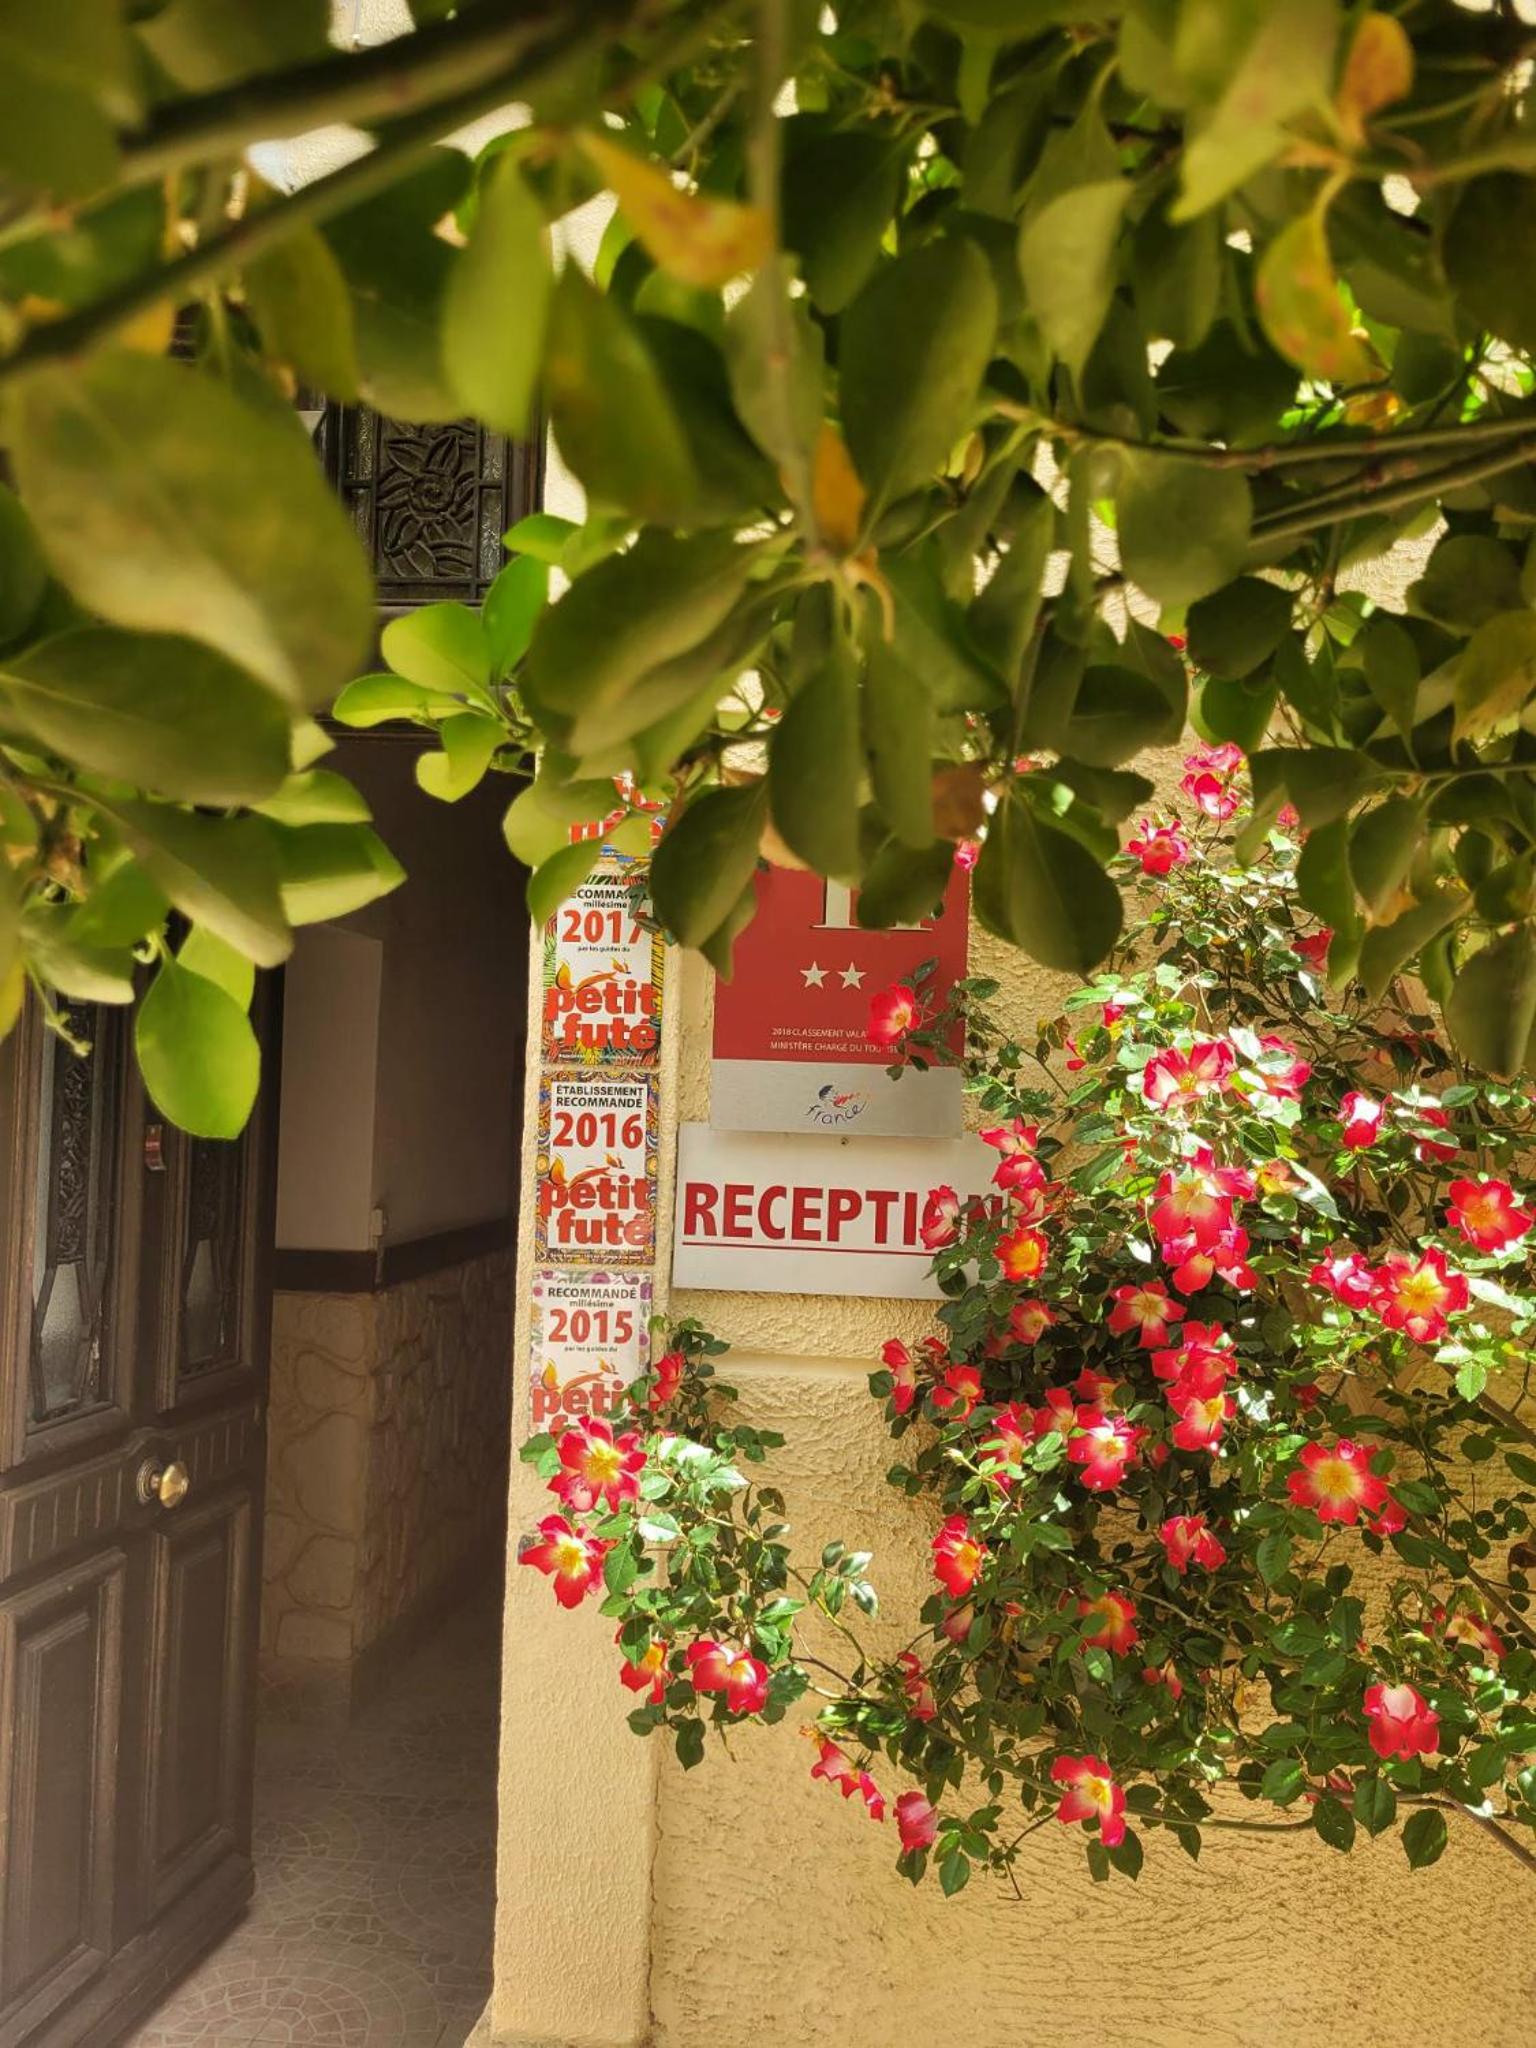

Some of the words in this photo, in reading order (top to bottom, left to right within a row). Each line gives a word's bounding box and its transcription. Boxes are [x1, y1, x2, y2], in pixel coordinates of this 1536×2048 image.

[562, 909, 648, 944] 2017
[546, 979, 658, 1021] petit
[563, 1013, 657, 1050] futé
[556, 1084, 644, 1096] ÉTABLISSEMENT
[553, 1112, 644, 1149] 2016
[540, 1174, 651, 1217] petit
[557, 1209, 652, 1246] futé
[548, 1286, 637, 1299] RECOMMANDÉ
[548, 1308, 633, 1345] 2015
